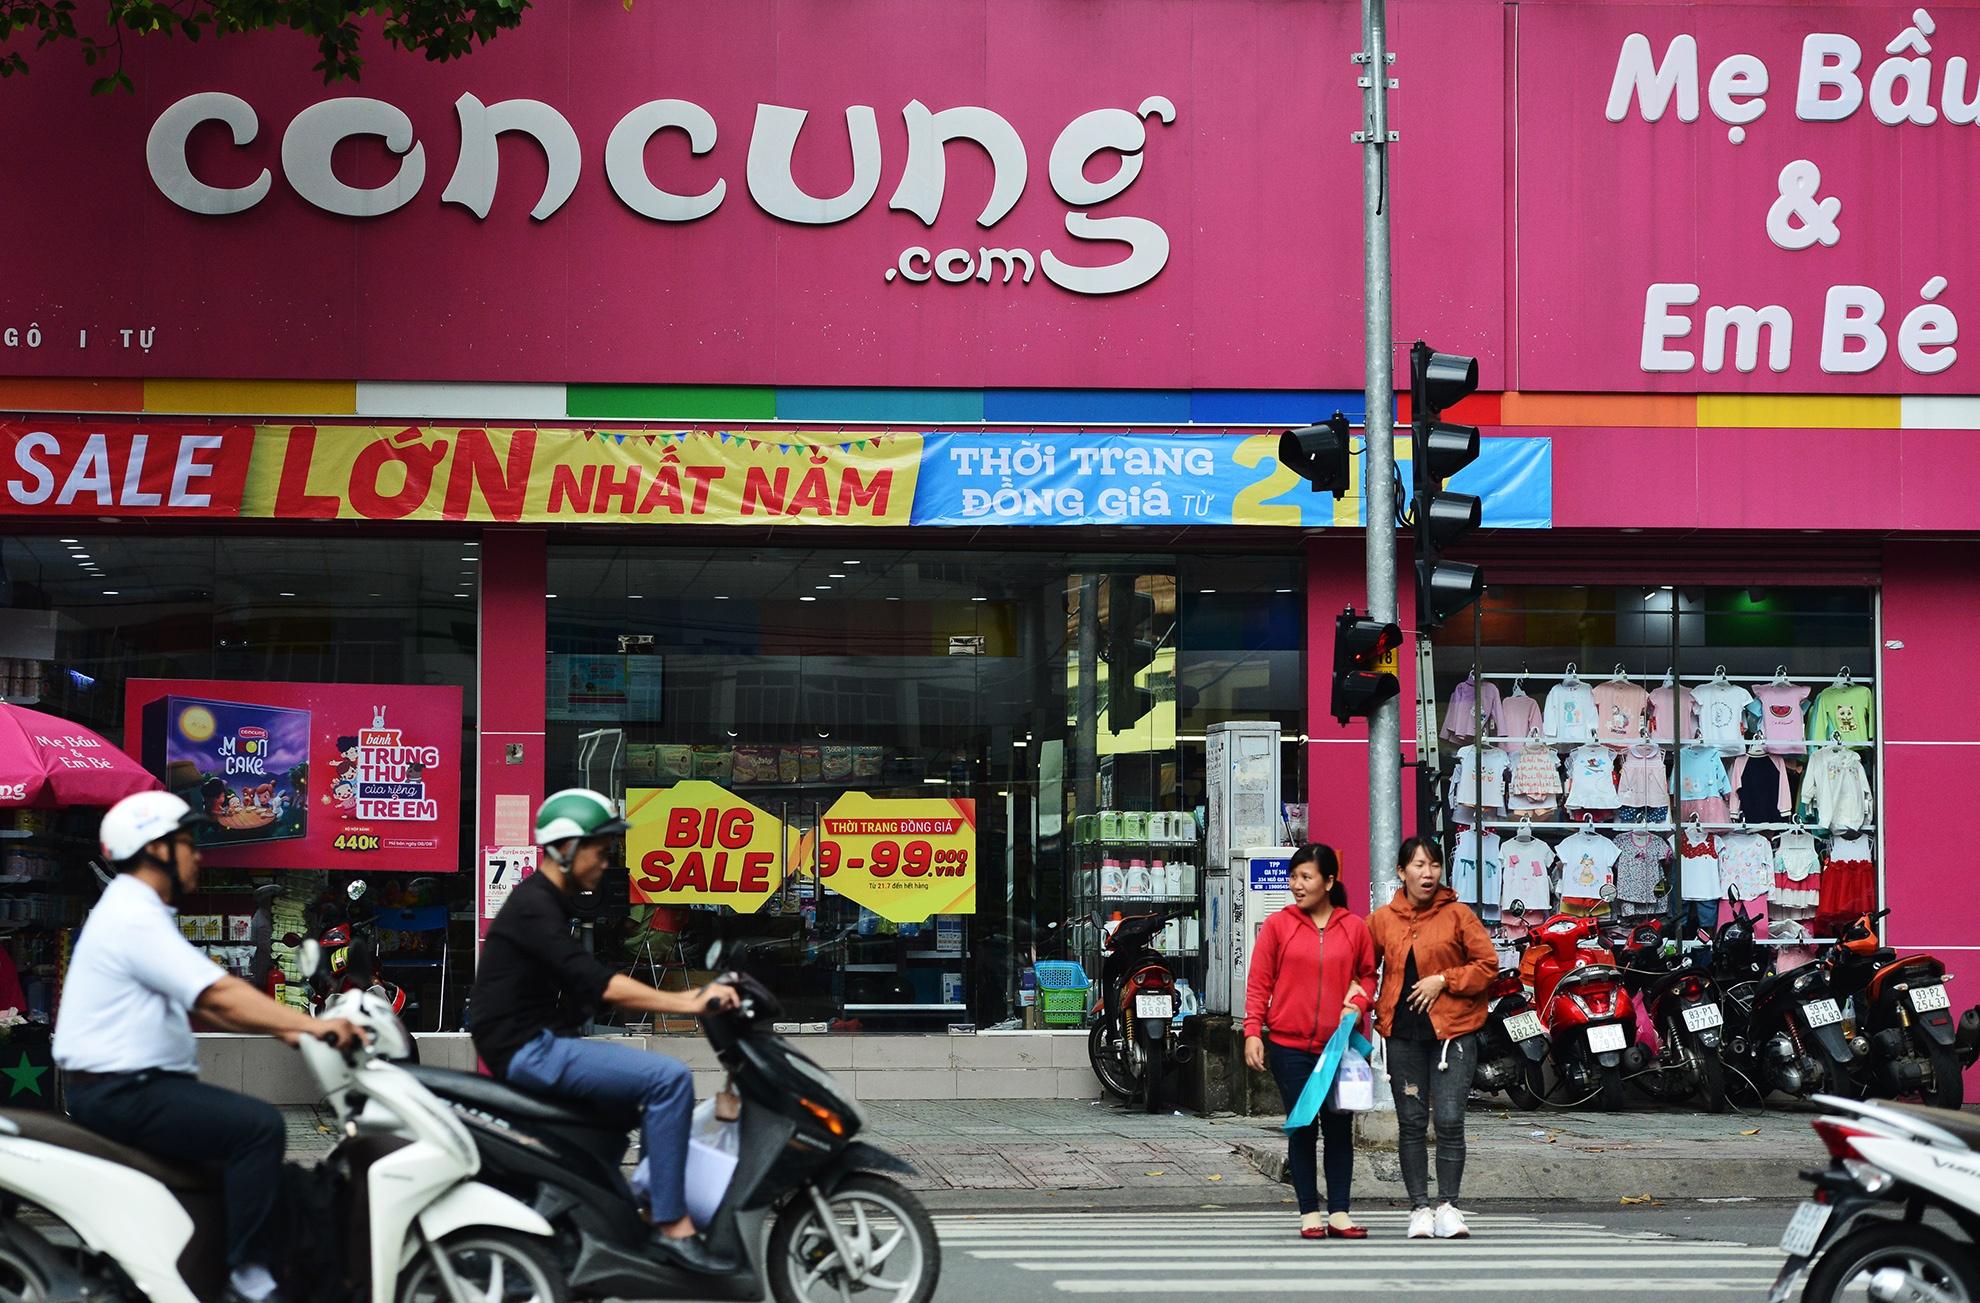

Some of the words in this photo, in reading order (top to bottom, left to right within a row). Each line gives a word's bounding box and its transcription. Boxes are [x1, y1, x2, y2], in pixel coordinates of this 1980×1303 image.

[1605, 33, 1769, 146] Mẹ
[147, 92, 1176, 295] concung
[1766, 159, 1842, 251] &
[1640, 283, 1793, 373] Em
[1820, 275, 1958, 374] Bé
[120, 327, 156, 353] TỰ
[7, 432, 223, 507] SALE
[274, 426, 537, 522] LỚN
[546, 445, 726, 515] NHẤT
[740, 455, 893, 516] NĂM
[962, 476, 1084, 516] ĐỒNG
[1181, 490, 1214, 516] TỪ
[366, 733, 391, 745] bánh
[59, 756, 90, 769] Em
[361, 748, 437, 766] TRUNG
[360, 765, 406, 782] THU
[364, 784, 386, 794] của
[387, 784, 417, 798] riêng
[359, 794, 400, 817] TRẺ
[403, 801, 435, 818] EM
[664, 807, 754, 849] BIG
[832, 819, 858, 833] THỜI
[861, 821, 898, 833] TRANG
[900, 818, 932, 833] ĐỒNG
[934, 819, 953, 833] GIÁ
[334, 835, 379, 850] 440K
[489, 860, 506, 885] 7
[637, 850, 774, 893] SALE
[914, 883, 929, 891] hàng
[1915, 987, 1941, 1000] 93-P2
[1142, 1006, 1168, 1016] 8596
[1808, 1001, 1834, 1015] 59-B1
[1915, 996, 1946, 1011] 254.37
[1688, 1006, 1714, 1020] 83-P1
[1810, 1010, 1841, 1027] 354.93
[1688, 1014, 1720, 1030] 377.07
[1511, 1023, 1541, 1041] 382.54
